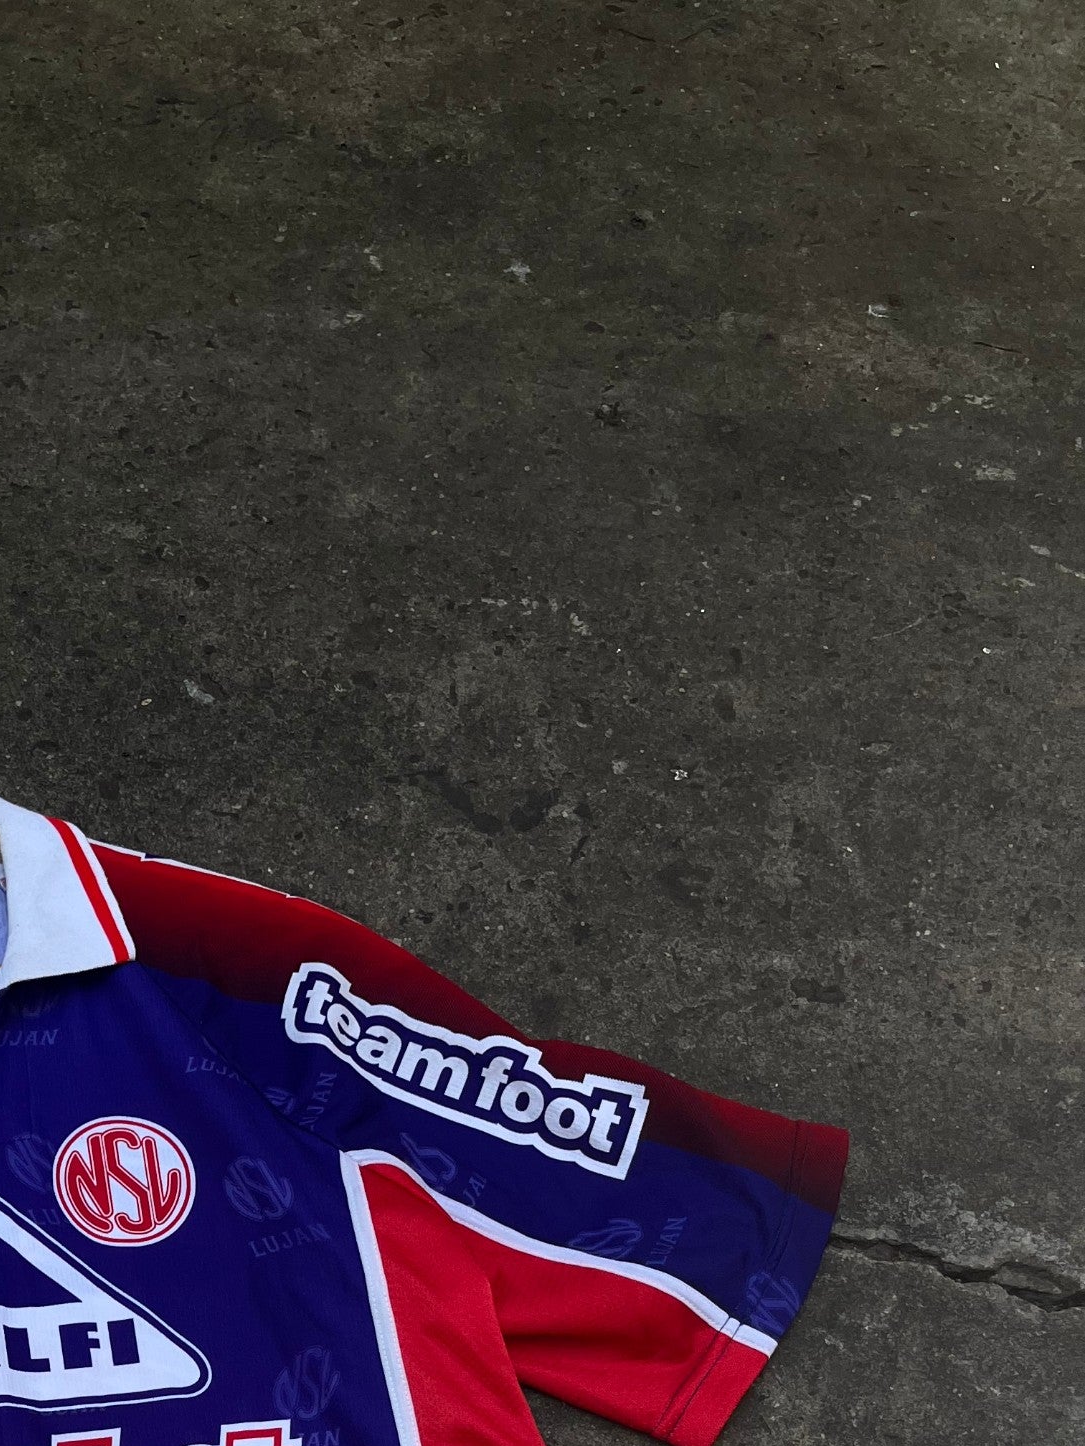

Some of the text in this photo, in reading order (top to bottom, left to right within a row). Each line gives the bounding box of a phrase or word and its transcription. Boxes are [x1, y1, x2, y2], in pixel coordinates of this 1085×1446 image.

[304, 979, 622, 1153] team foot
[66, 1127, 183, 1235] NSL
[248, 1224, 333, 1258] LUJAN
